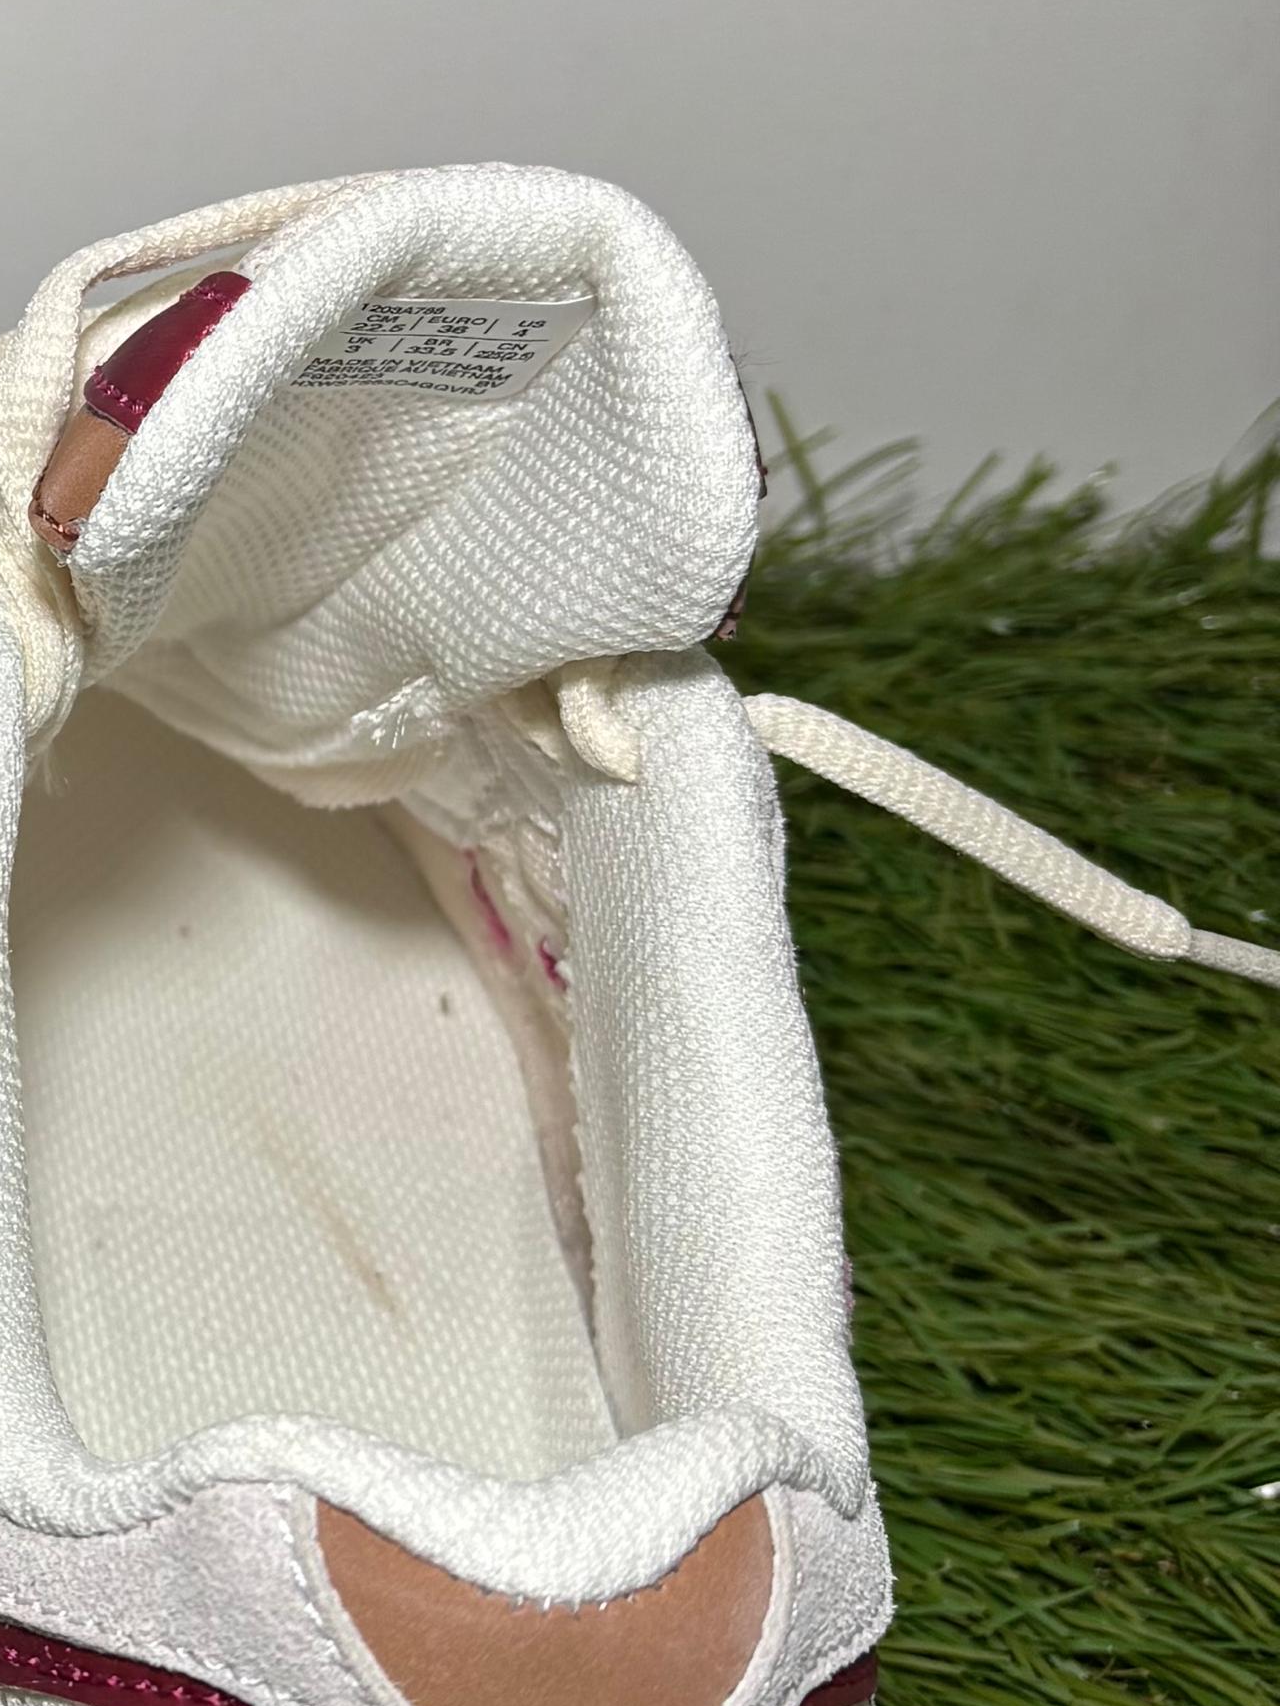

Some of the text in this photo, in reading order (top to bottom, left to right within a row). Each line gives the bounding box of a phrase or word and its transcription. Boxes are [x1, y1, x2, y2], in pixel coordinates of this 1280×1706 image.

[366, 314, 547, 329] CM EURO US
[350, 322, 529, 337] 22.5 36 4
[344, 345, 361, 353] 3
[403, 345, 458, 356] 33.5
[347, 336, 529, 351] UK BR CN
[303, 364, 513, 381] FABRIQUE AU VIETNAM
[310, 357, 505, 373] MADE IN VIETNAM
